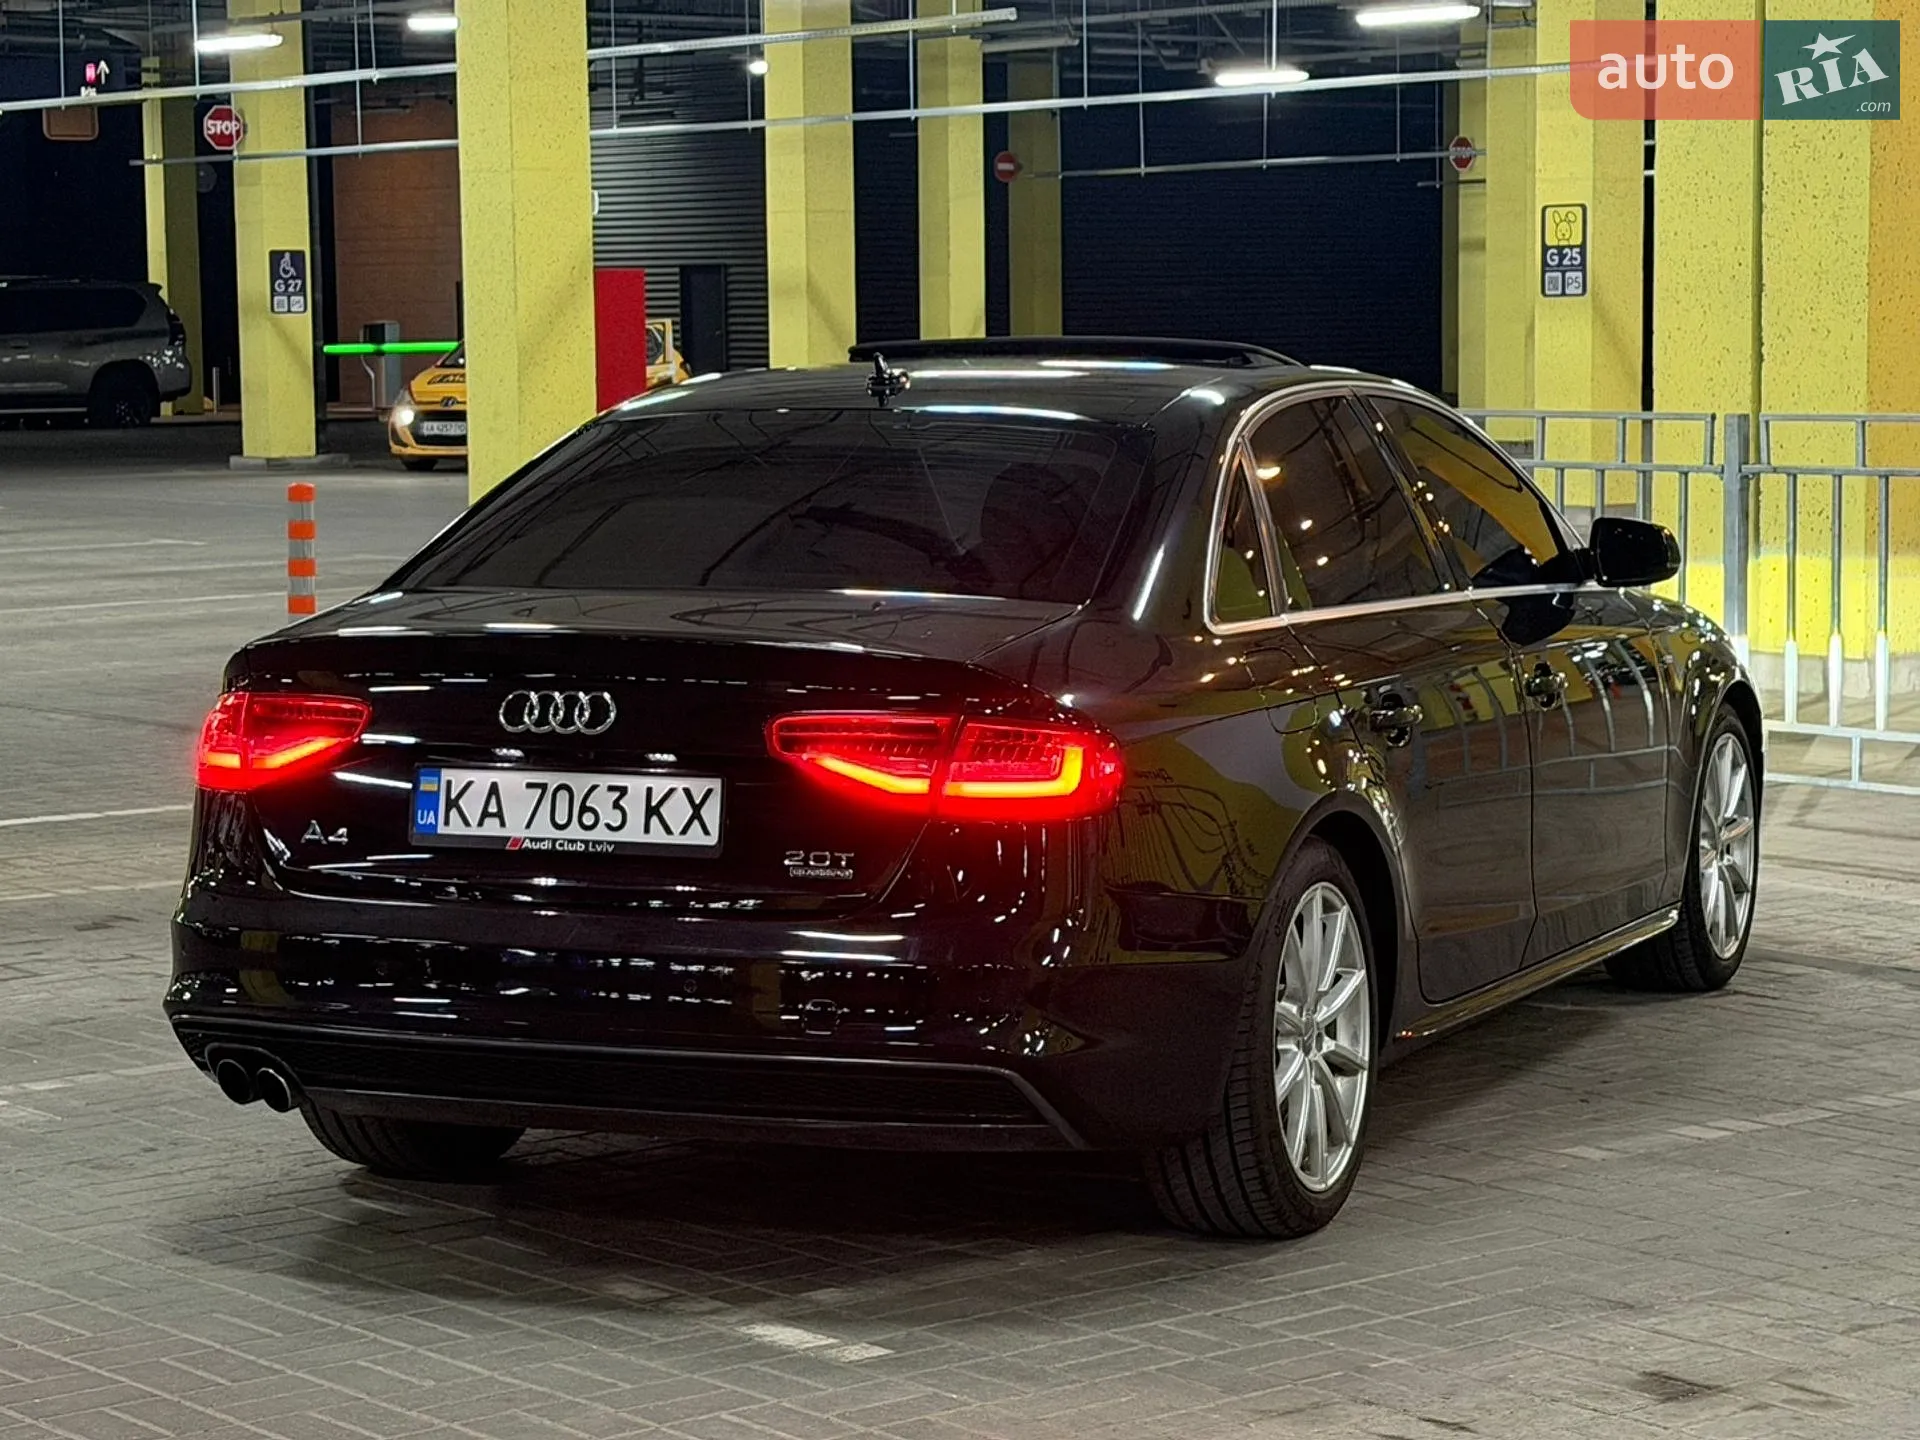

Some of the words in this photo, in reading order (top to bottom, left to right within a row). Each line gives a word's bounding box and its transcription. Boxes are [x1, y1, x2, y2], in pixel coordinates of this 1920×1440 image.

[207, 119, 240, 136] STOP
[1546, 248, 1559, 266] G
[1562, 248, 1581, 265] 25
[274, 279, 286, 292] G
[287, 278, 302, 292] 27
[417, 808, 436, 826] UA
[443, 779, 507, 828] KA
[524, 781, 629, 833] 7063
[643, 785, 715, 837] KX
[300, 819, 349, 846] A4
[521, 838, 552, 850] Audi
[555, 839, 586, 852] Club
[588, 841, 616, 853] Lviv
